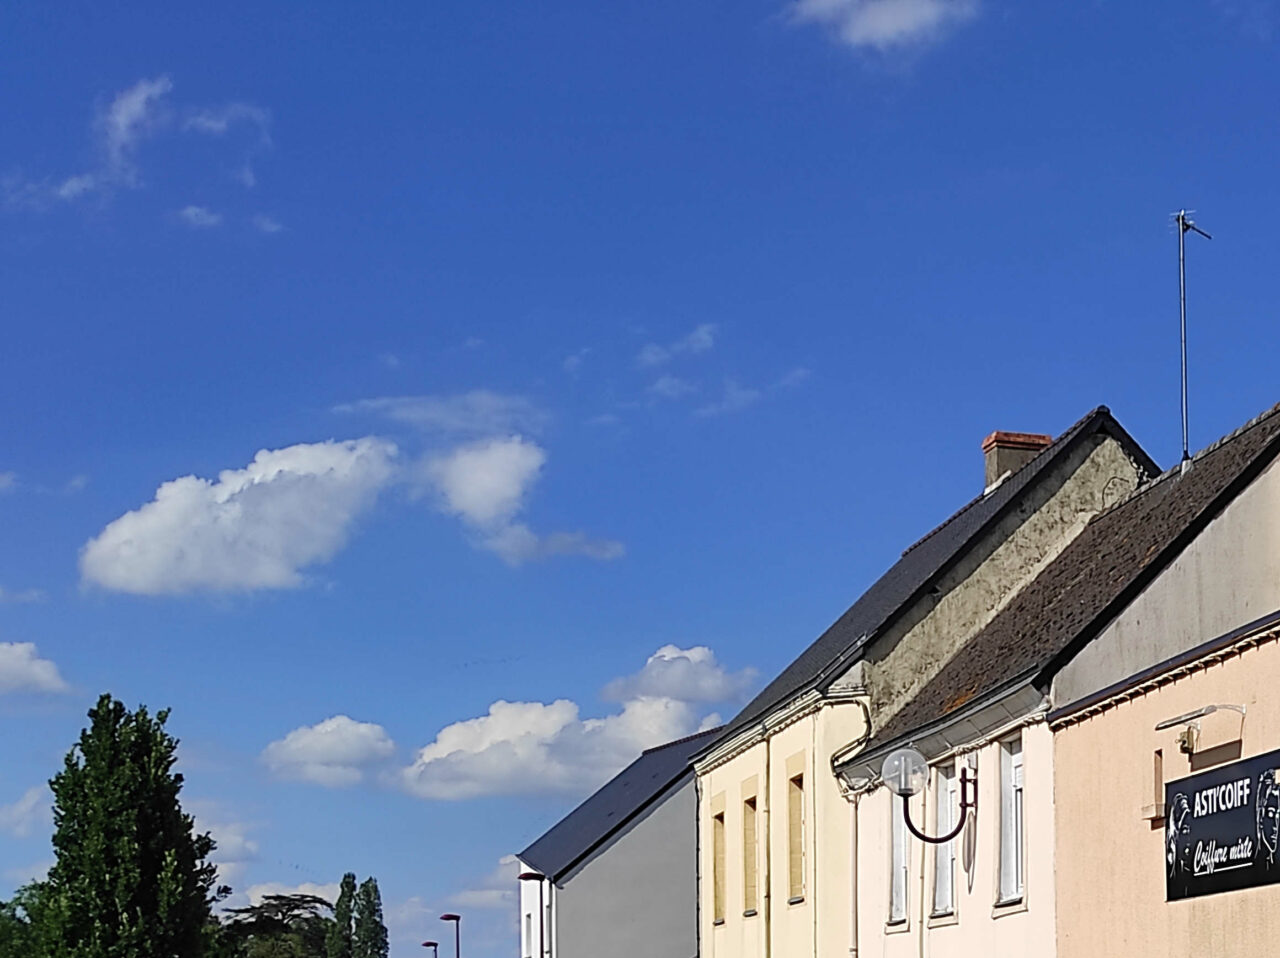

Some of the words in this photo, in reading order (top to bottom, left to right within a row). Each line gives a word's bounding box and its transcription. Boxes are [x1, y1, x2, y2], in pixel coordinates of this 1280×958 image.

[1193, 778, 1251, 818] ASTI'COIFF
[1193, 840, 1228, 874] Coiffure
[1229, 836, 1253, 860] mixte
